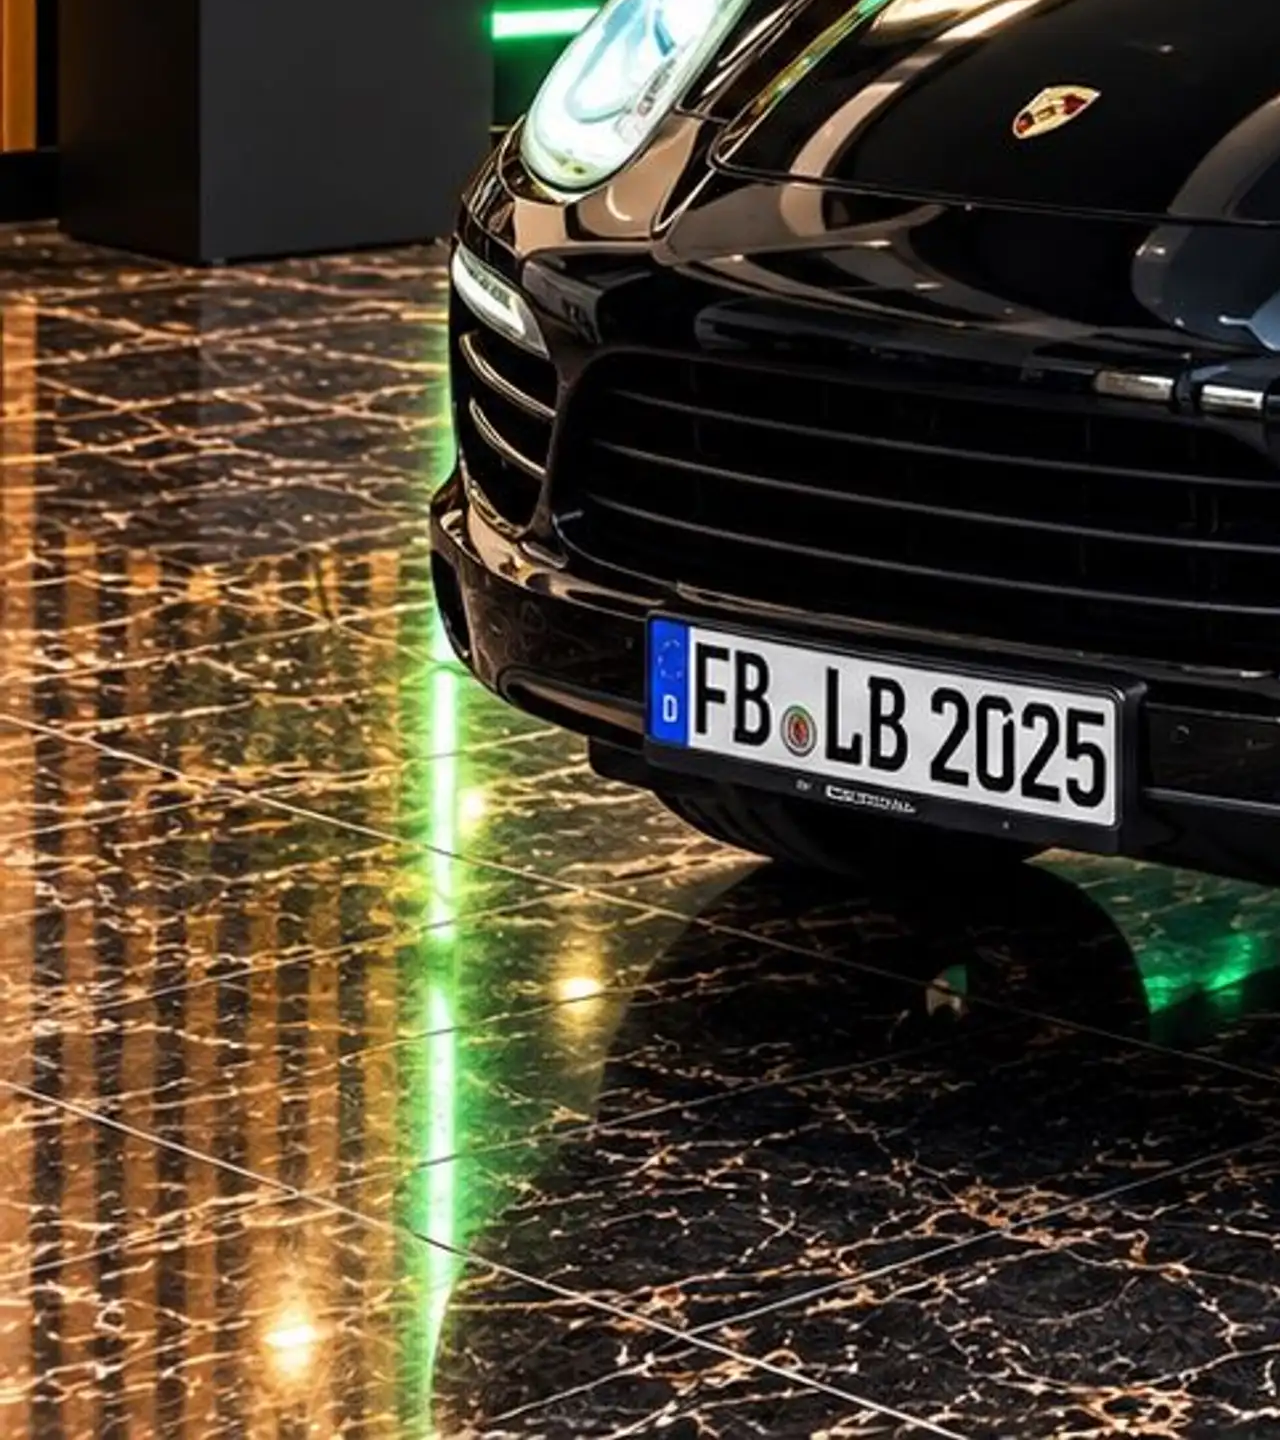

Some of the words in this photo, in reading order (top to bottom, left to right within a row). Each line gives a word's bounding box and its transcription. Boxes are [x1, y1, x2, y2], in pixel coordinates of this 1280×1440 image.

[662, 693, 678, 723] D
[695, 641, 771, 747] FB
[825, 666, 909, 773] LB
[930, 686, 1107, 809] 2025
